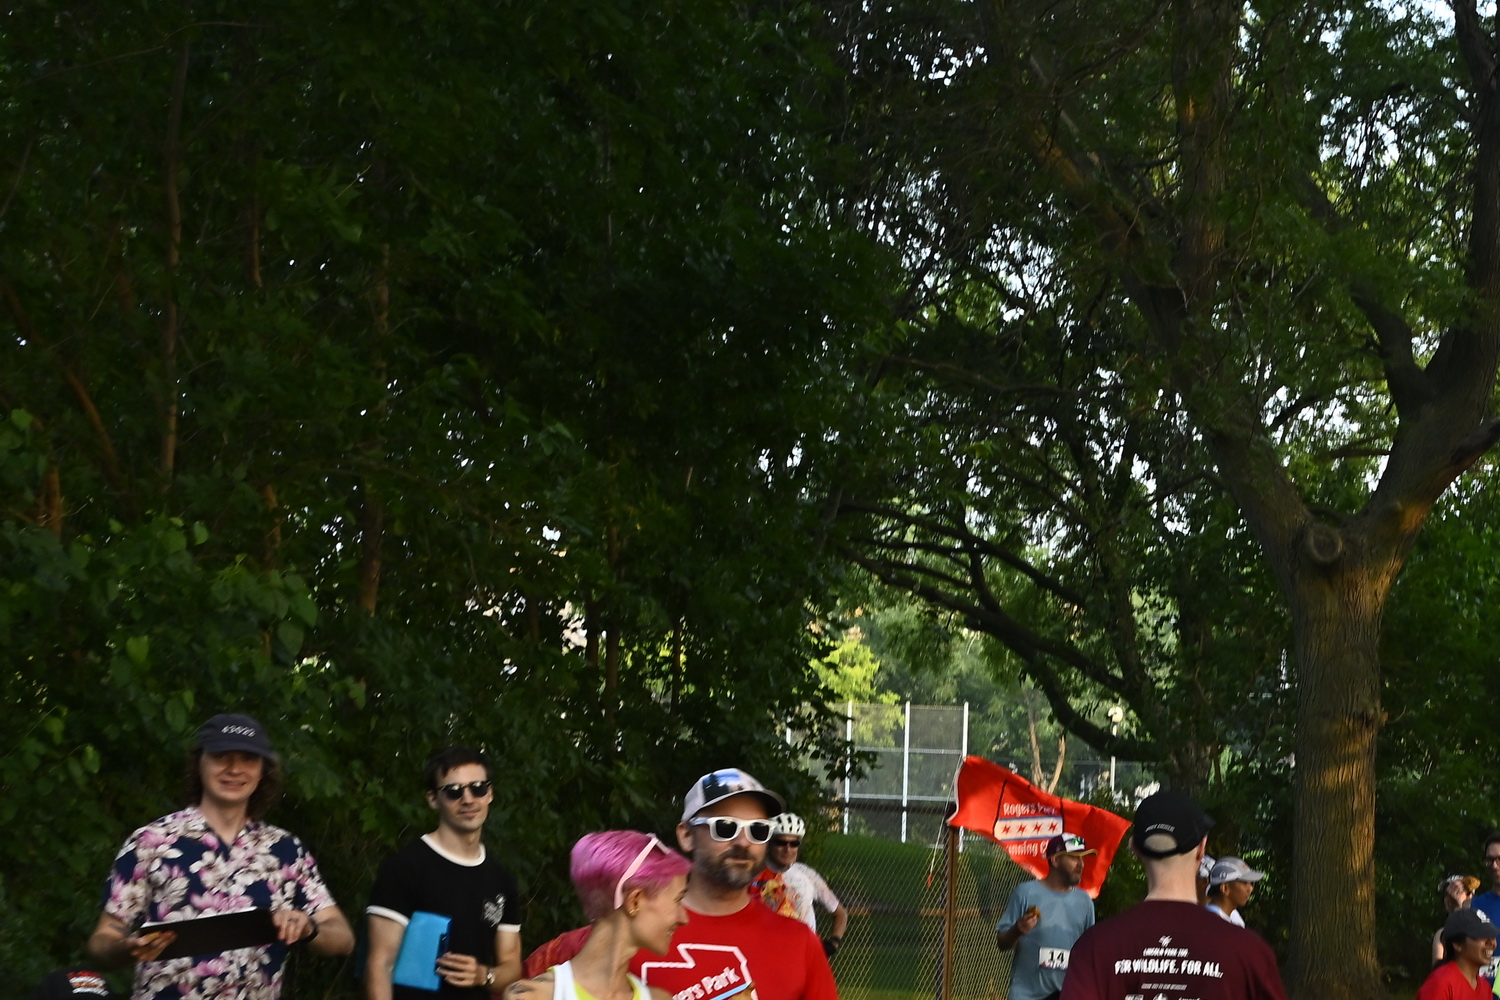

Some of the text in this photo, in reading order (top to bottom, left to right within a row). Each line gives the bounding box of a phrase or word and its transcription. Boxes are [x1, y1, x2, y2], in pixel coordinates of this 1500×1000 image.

[1003, 802, 1037, 817] Rogers
[1006, 841, 1038, 857] unning
[1048, 950, 1065, 964] 14
[1181, 960, 1202, 976] FOR
[701, 966, 741, 995] Park
